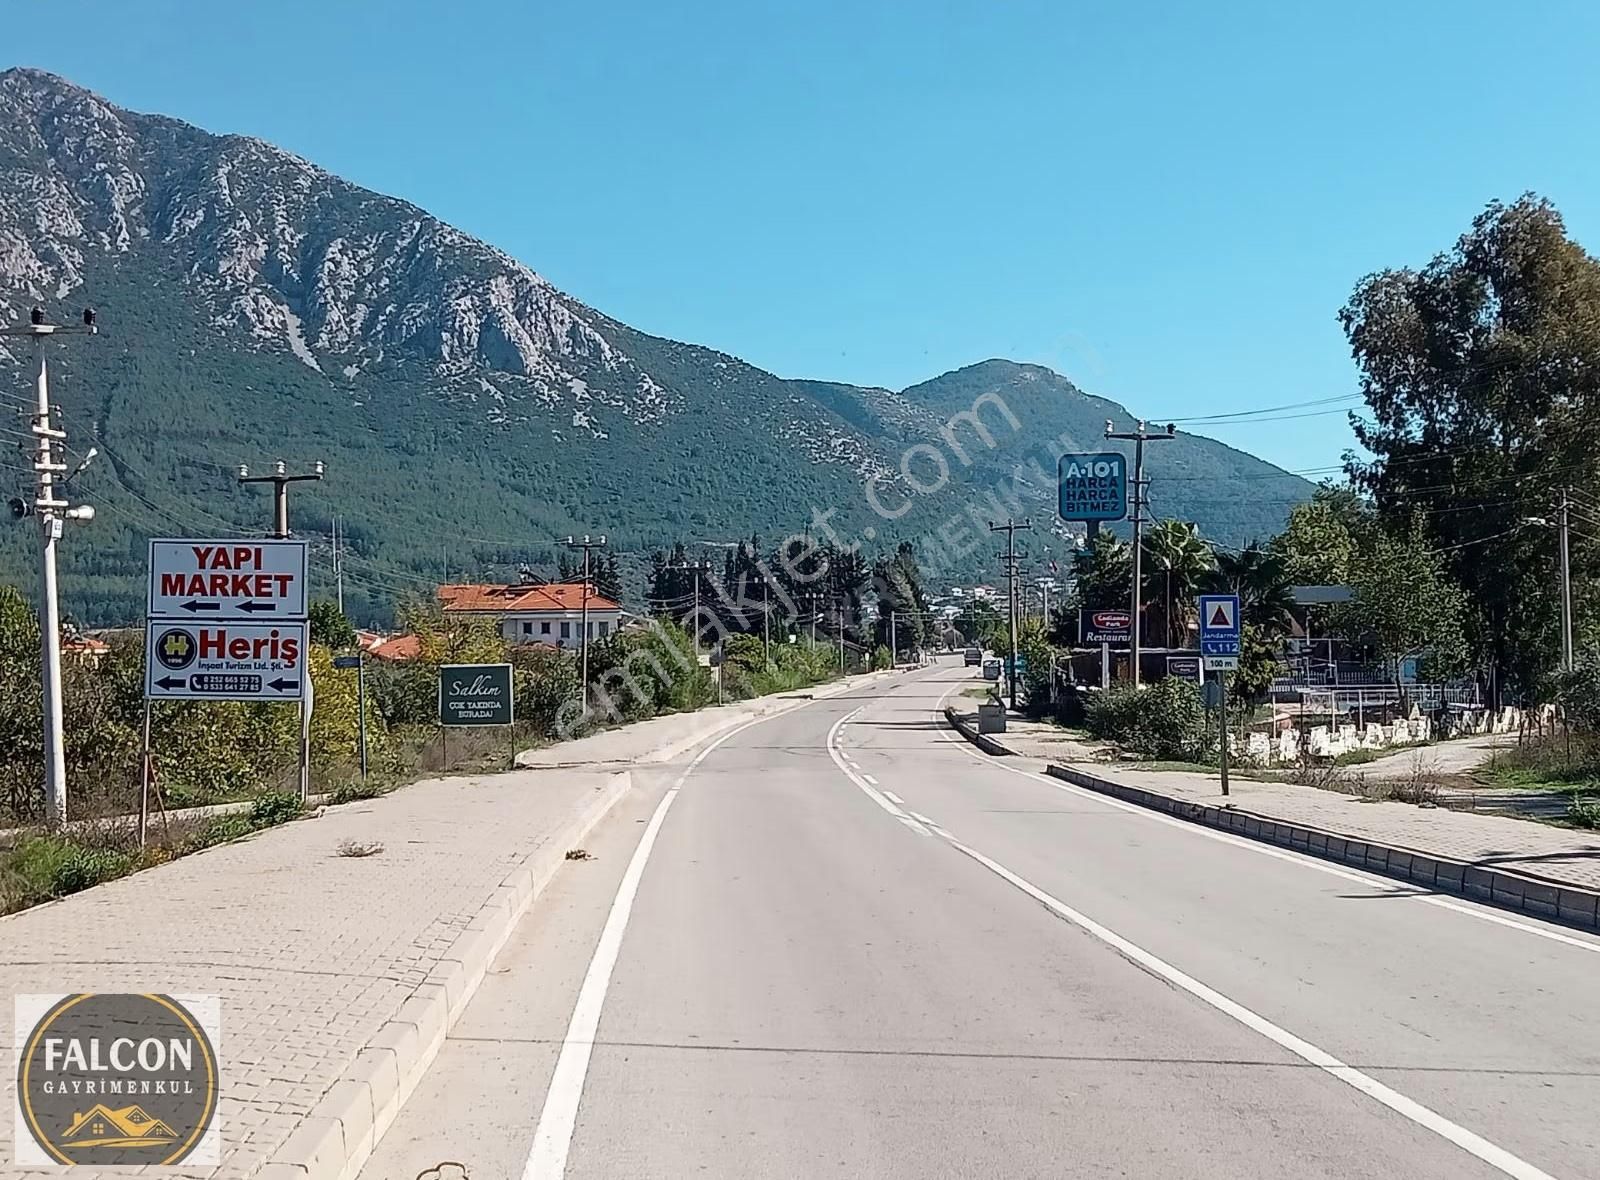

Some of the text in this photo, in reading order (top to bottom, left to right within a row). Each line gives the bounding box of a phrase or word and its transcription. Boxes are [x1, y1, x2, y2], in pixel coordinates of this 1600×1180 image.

[1066, 477, 1119, 489] HARCA
[1066, 489, 1119, 501] HARCA
[192, 547, 262, 570] YAPI
[161, 574, 294, 597] MARKET
[200, 630, 299, 669] Heriş
[1218, 643, 1239, 652] 112
[225, 661, 251, 670] Turizm
[253, 662, 268, 670] Ltd.
